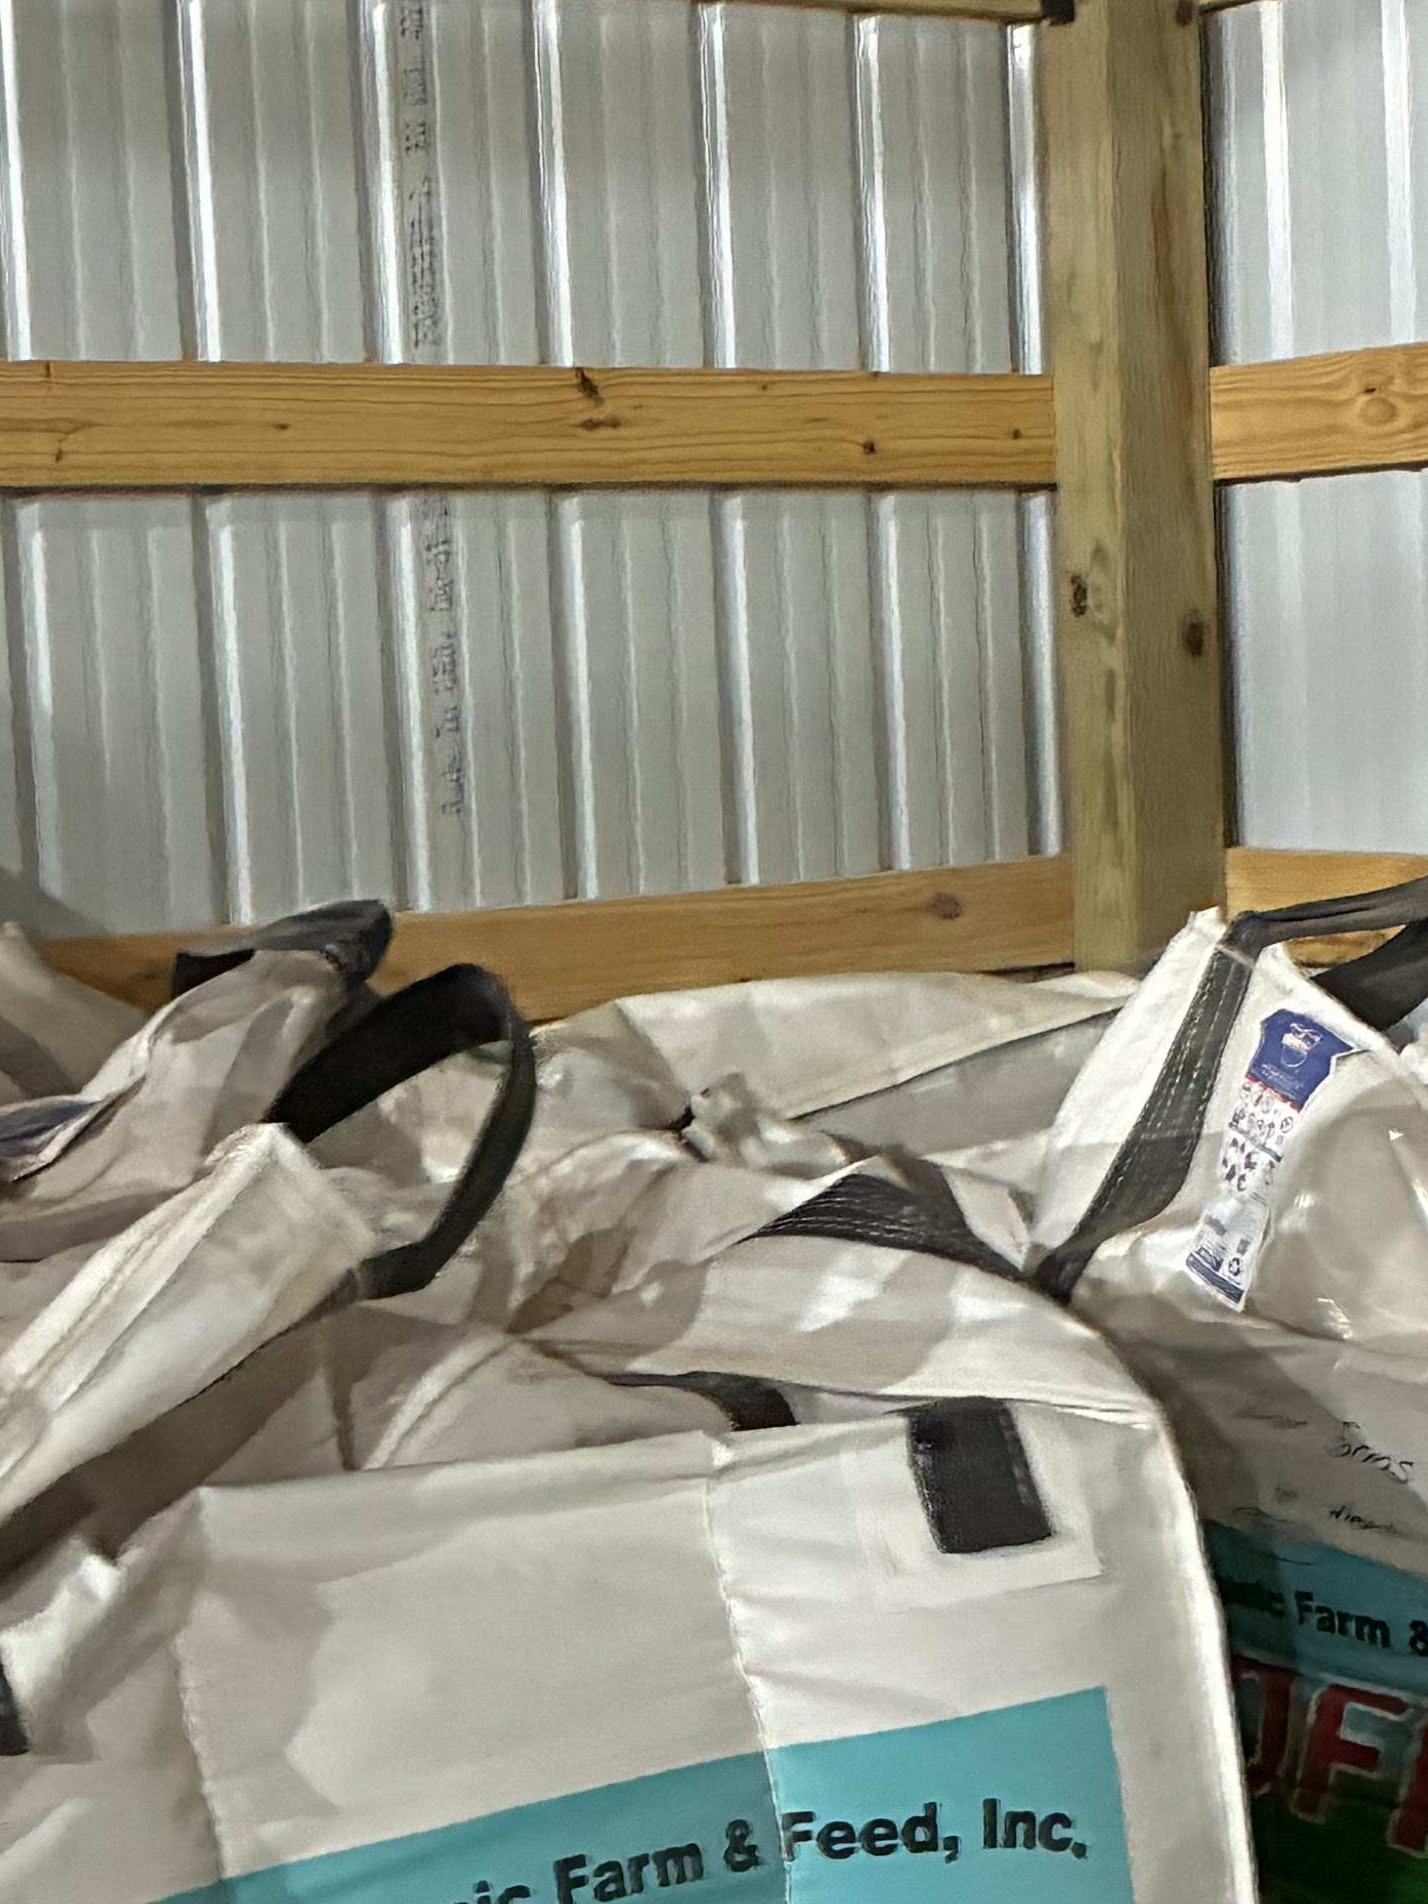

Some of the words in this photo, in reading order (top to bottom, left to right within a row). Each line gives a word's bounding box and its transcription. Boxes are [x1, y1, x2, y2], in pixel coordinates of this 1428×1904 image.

[1295, 1590, 1390, 1649] Farm
[723, 1818, 762, 1873] &
[780, 1801, 961, 1864] Feed,
[981, 1797, 1089, 1860] Inc.
